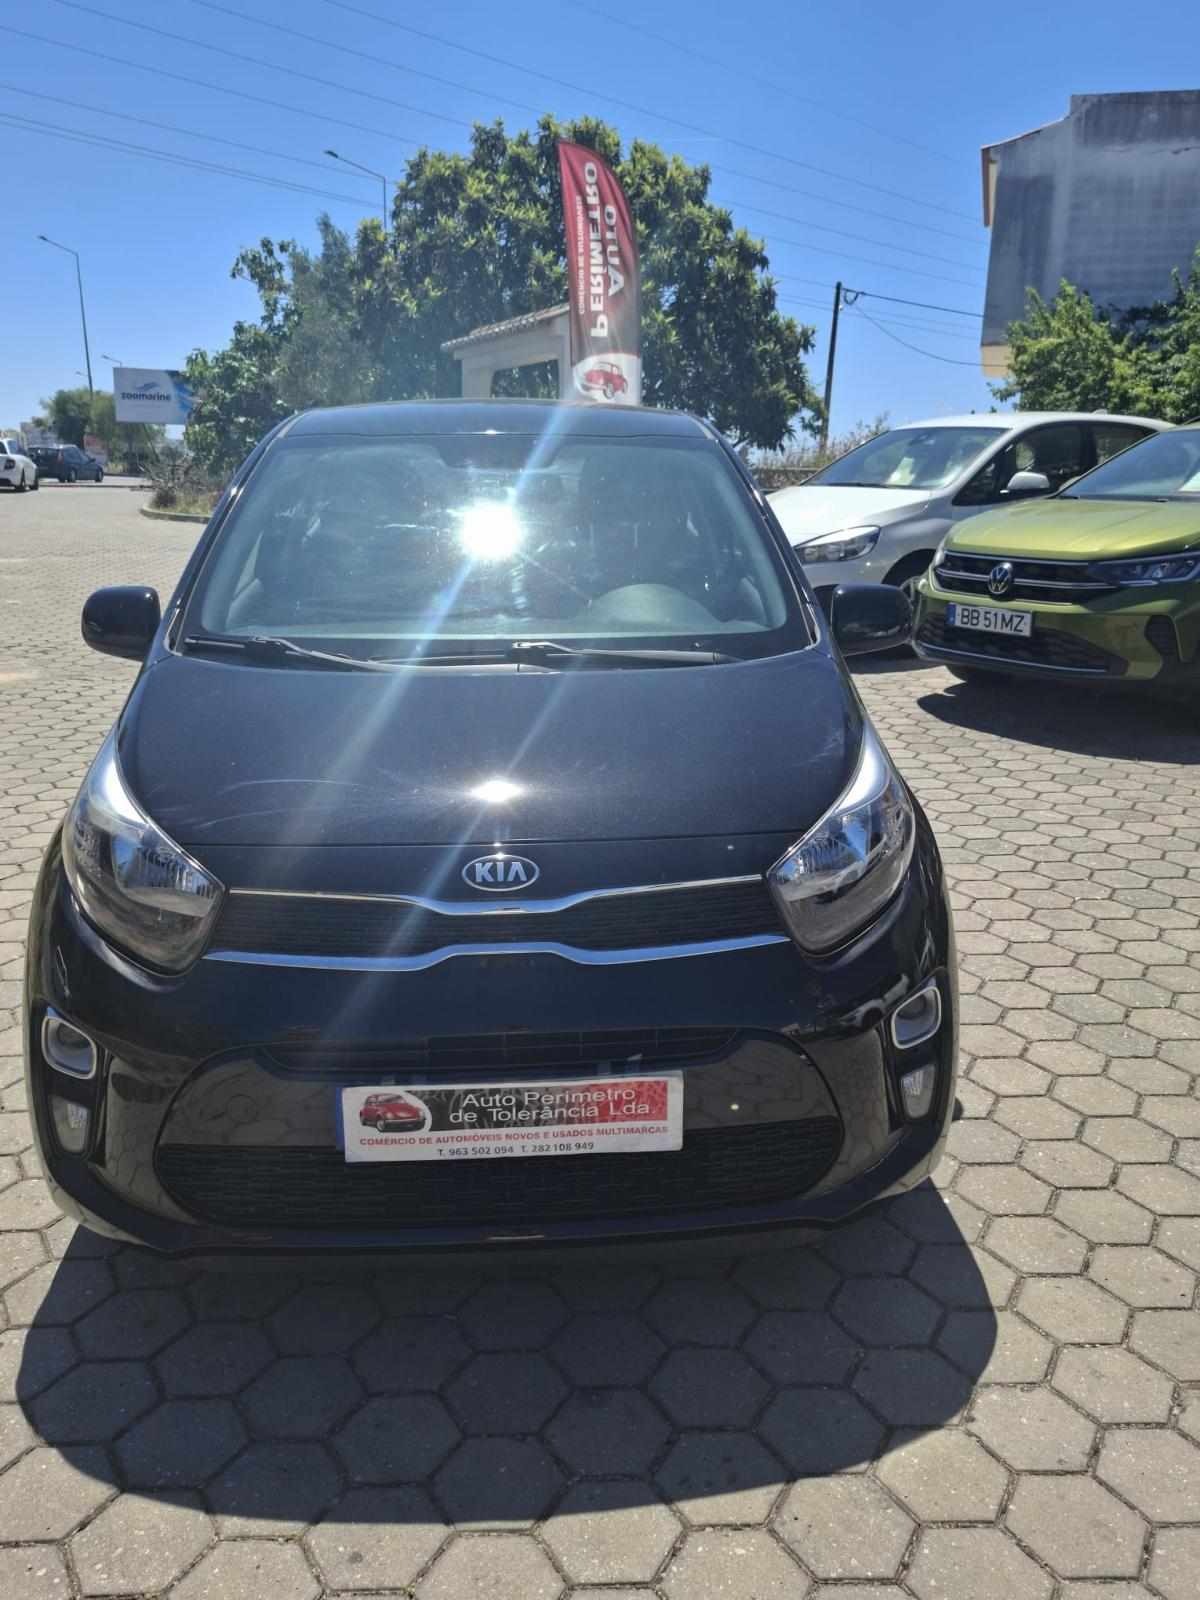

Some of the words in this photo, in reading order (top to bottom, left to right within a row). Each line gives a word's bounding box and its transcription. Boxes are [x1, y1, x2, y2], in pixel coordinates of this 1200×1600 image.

[121, 392, 171, 401] zoomarine
[475, 861, 527, 882] KIA
[462, 1093, 516, 1107] Auto
[449, 1108, 478, 1124] de
[488, 1102, 599, 1122] Tolerância
[418, 1136, 433, 1145] DE
[505, 1131, 541, 1141] NOVOS
[543, 1131, 550, 1139] E
[552, 1128, 594, 1139] USADOS
[595, 1125, 669, 1137] MULTIMARCAS
[471, 1145, 491, 1155] 502
